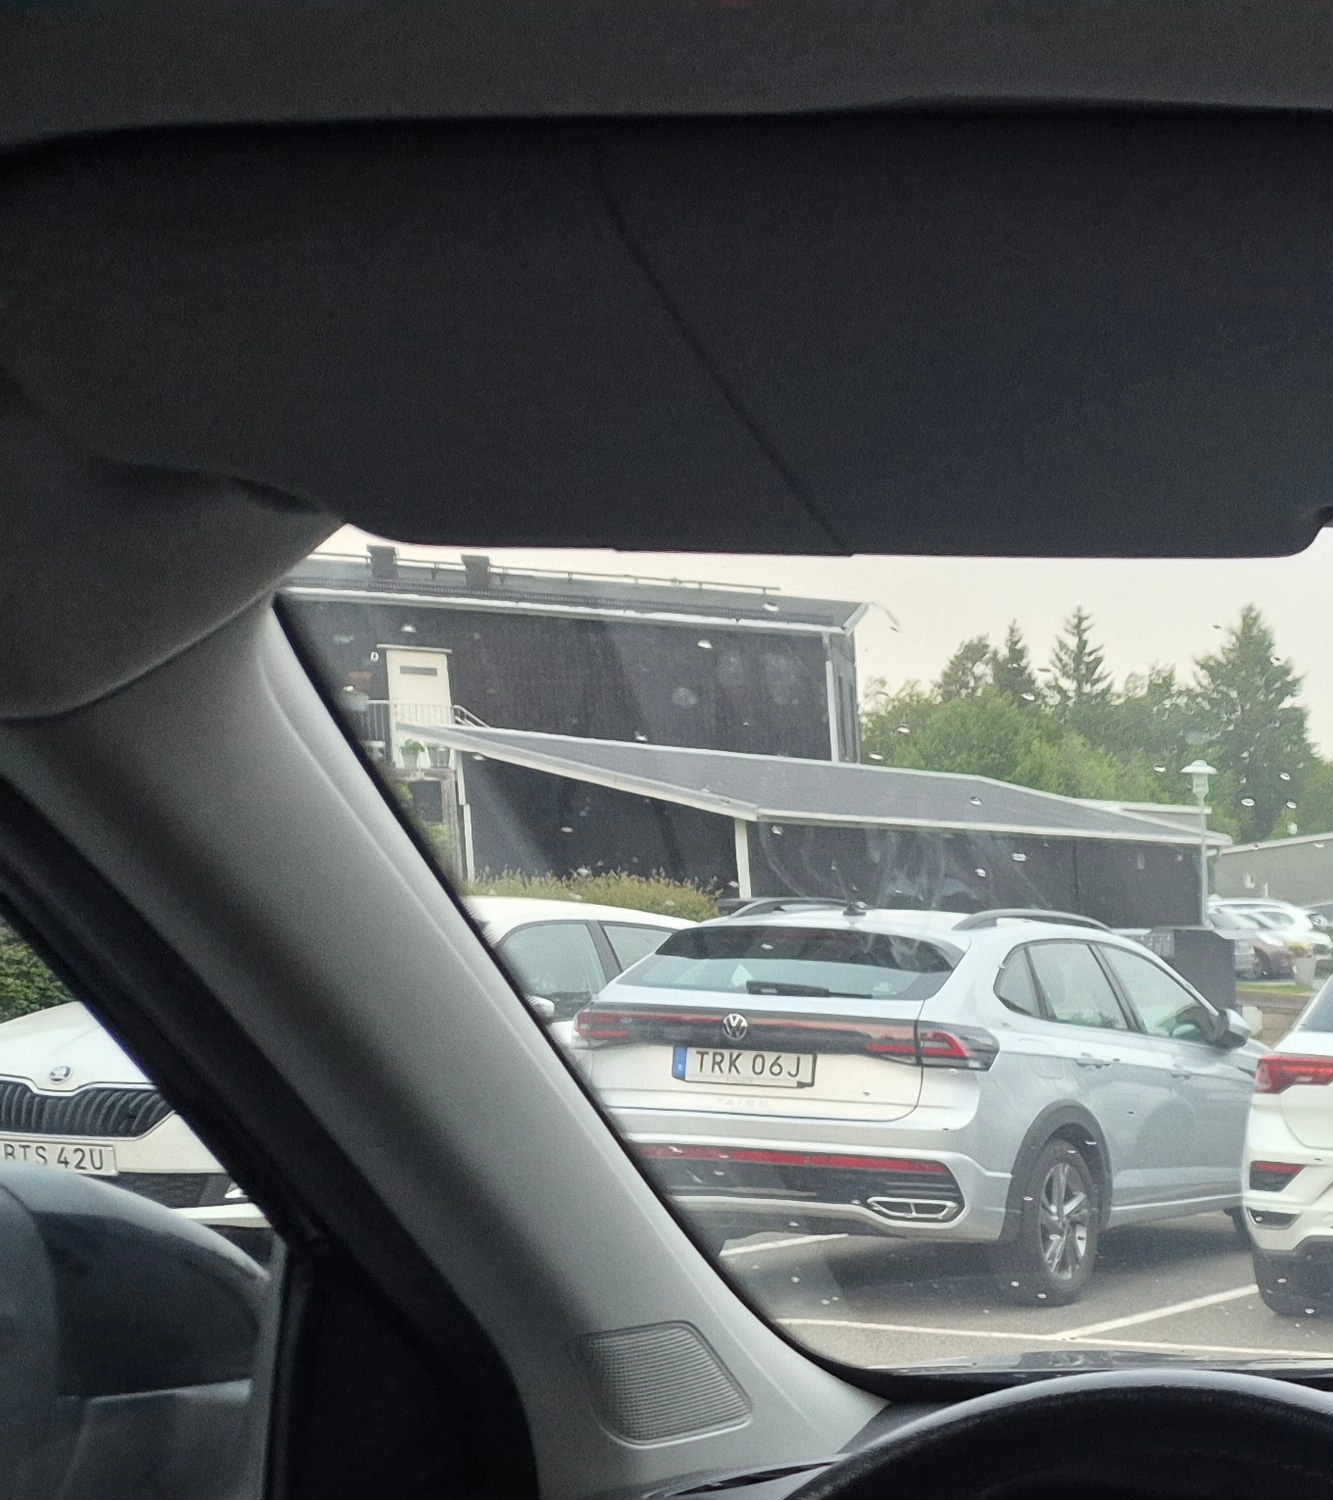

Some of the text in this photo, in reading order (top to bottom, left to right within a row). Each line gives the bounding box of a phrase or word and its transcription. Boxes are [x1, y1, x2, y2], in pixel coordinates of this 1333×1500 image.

[695, 1050, 801, 1078] TRK 06J
[57, 1147, 104, 1171] 42U
